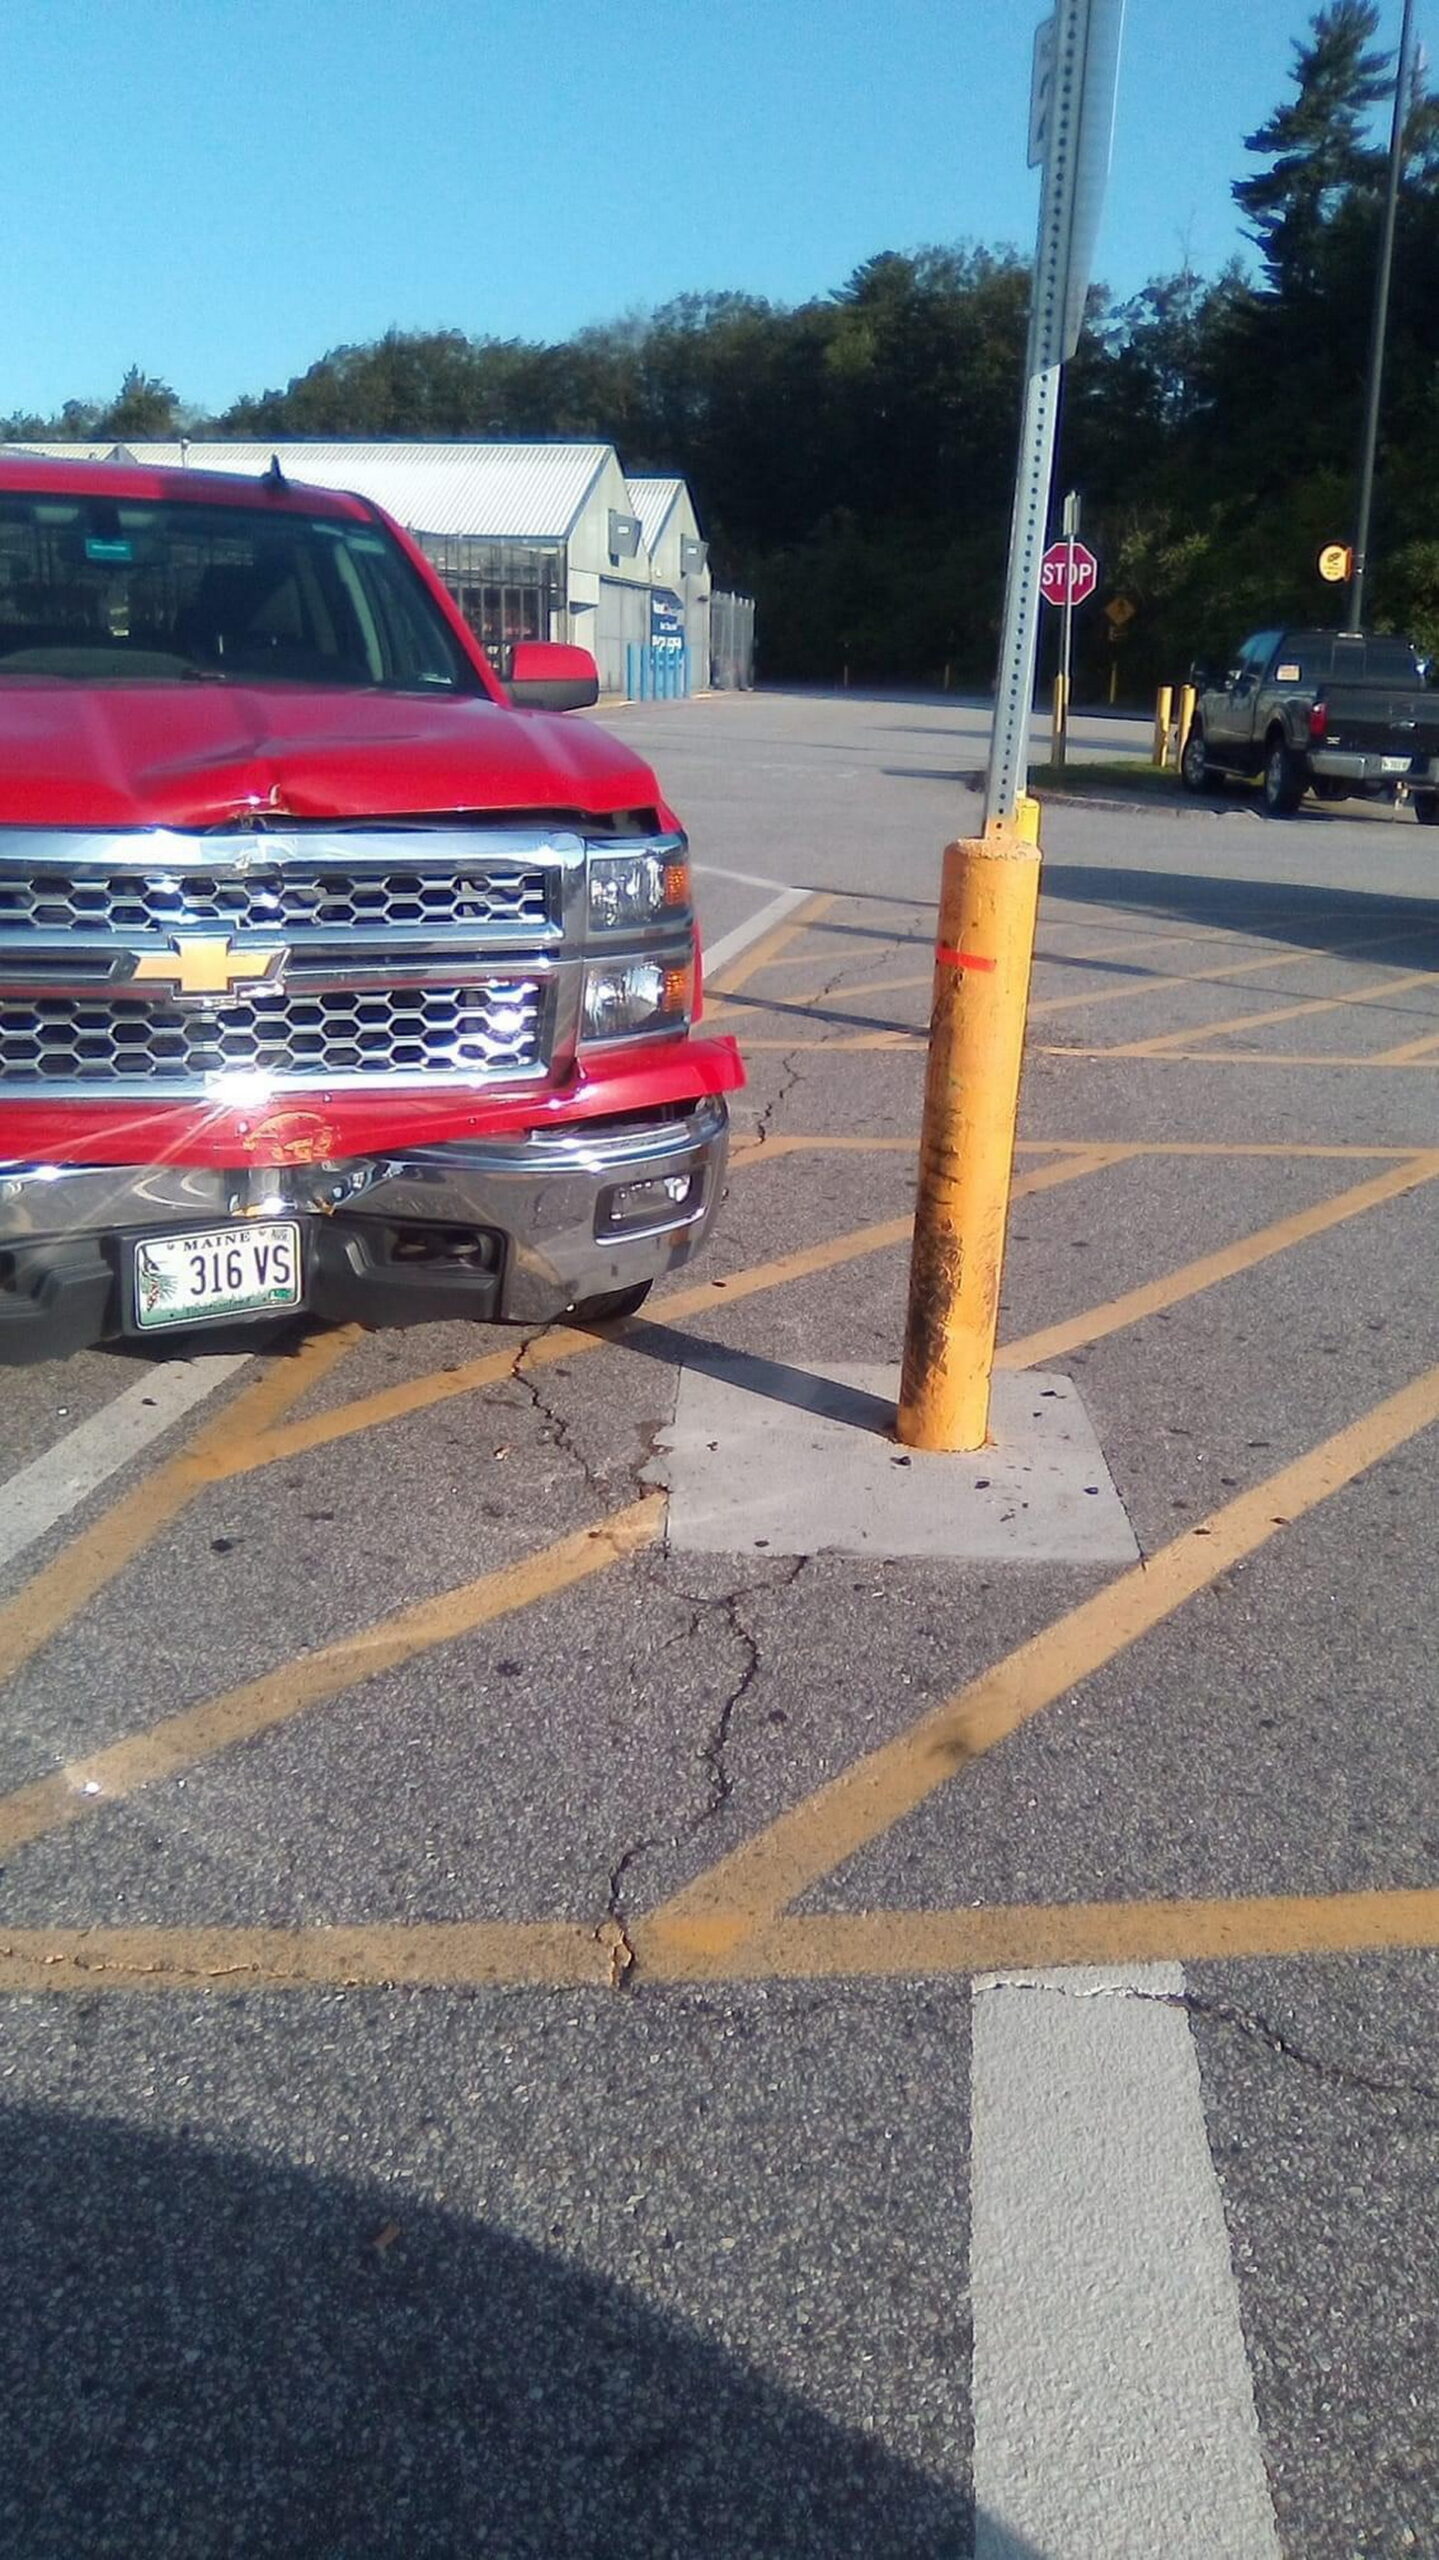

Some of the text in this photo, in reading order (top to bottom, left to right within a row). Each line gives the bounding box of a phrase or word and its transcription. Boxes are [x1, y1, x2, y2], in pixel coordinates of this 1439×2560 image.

[1042, 563, 1092, 585] STOP
[183, 1232, 251, 1252] MAINE
[190, 1245, 290, 1295] 316 VS
